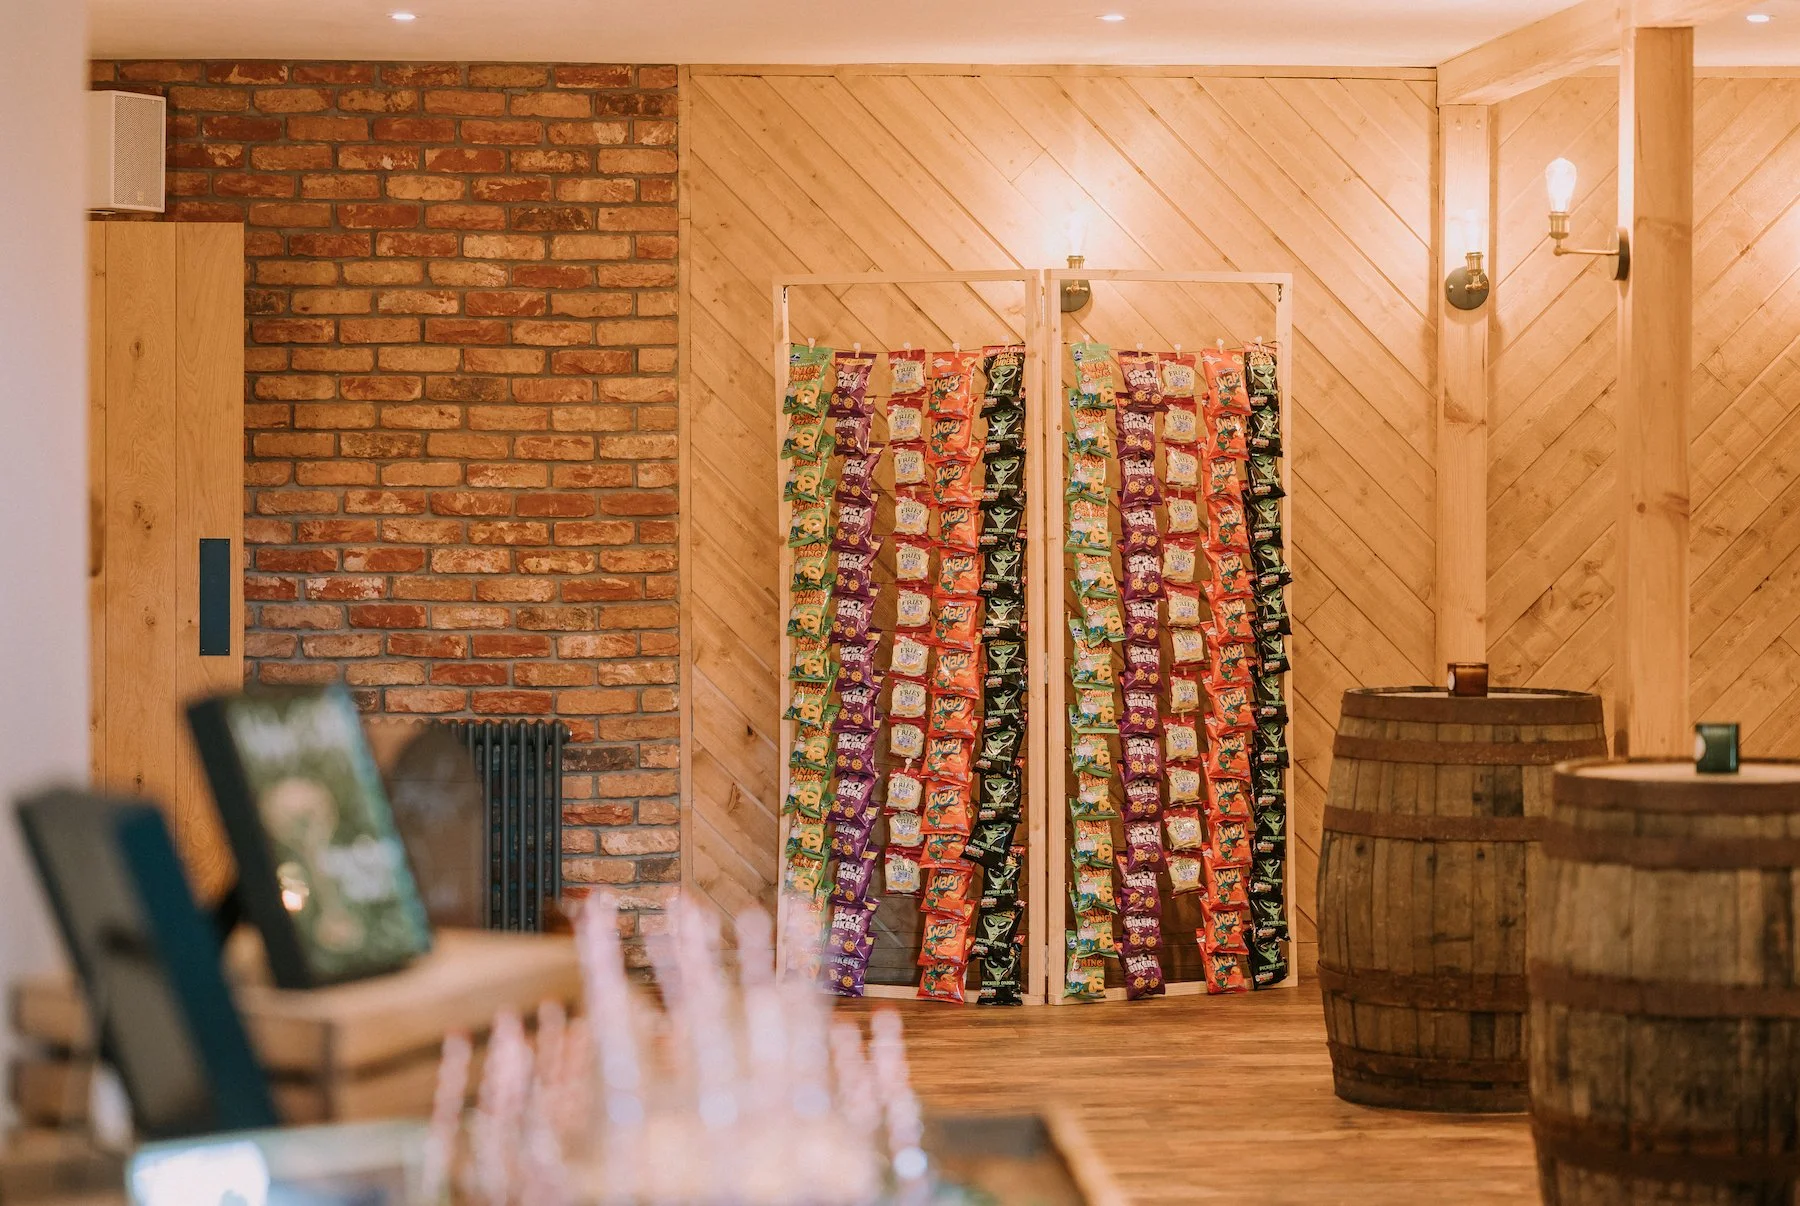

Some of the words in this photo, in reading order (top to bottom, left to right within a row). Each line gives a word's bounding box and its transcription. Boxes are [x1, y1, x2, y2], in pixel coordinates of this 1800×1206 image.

[893, 413, 914, 421] FRIES
[897, 457, 917, 465] FRIES
[901, 506, 921, 515] FRIES
[901, 552, 920, 561] FRIES
[902, 599, 922, 608] FRIES
[899, 646, 921, 656] FRIES
[899, 689, 919, 697] FRIES
[896, 730, 917, 740] FRIES
[893, 781, 914, 791] FRIES
[895, 815, 918, 826] FRIES
[892, 864, 913, 874] FRIES
